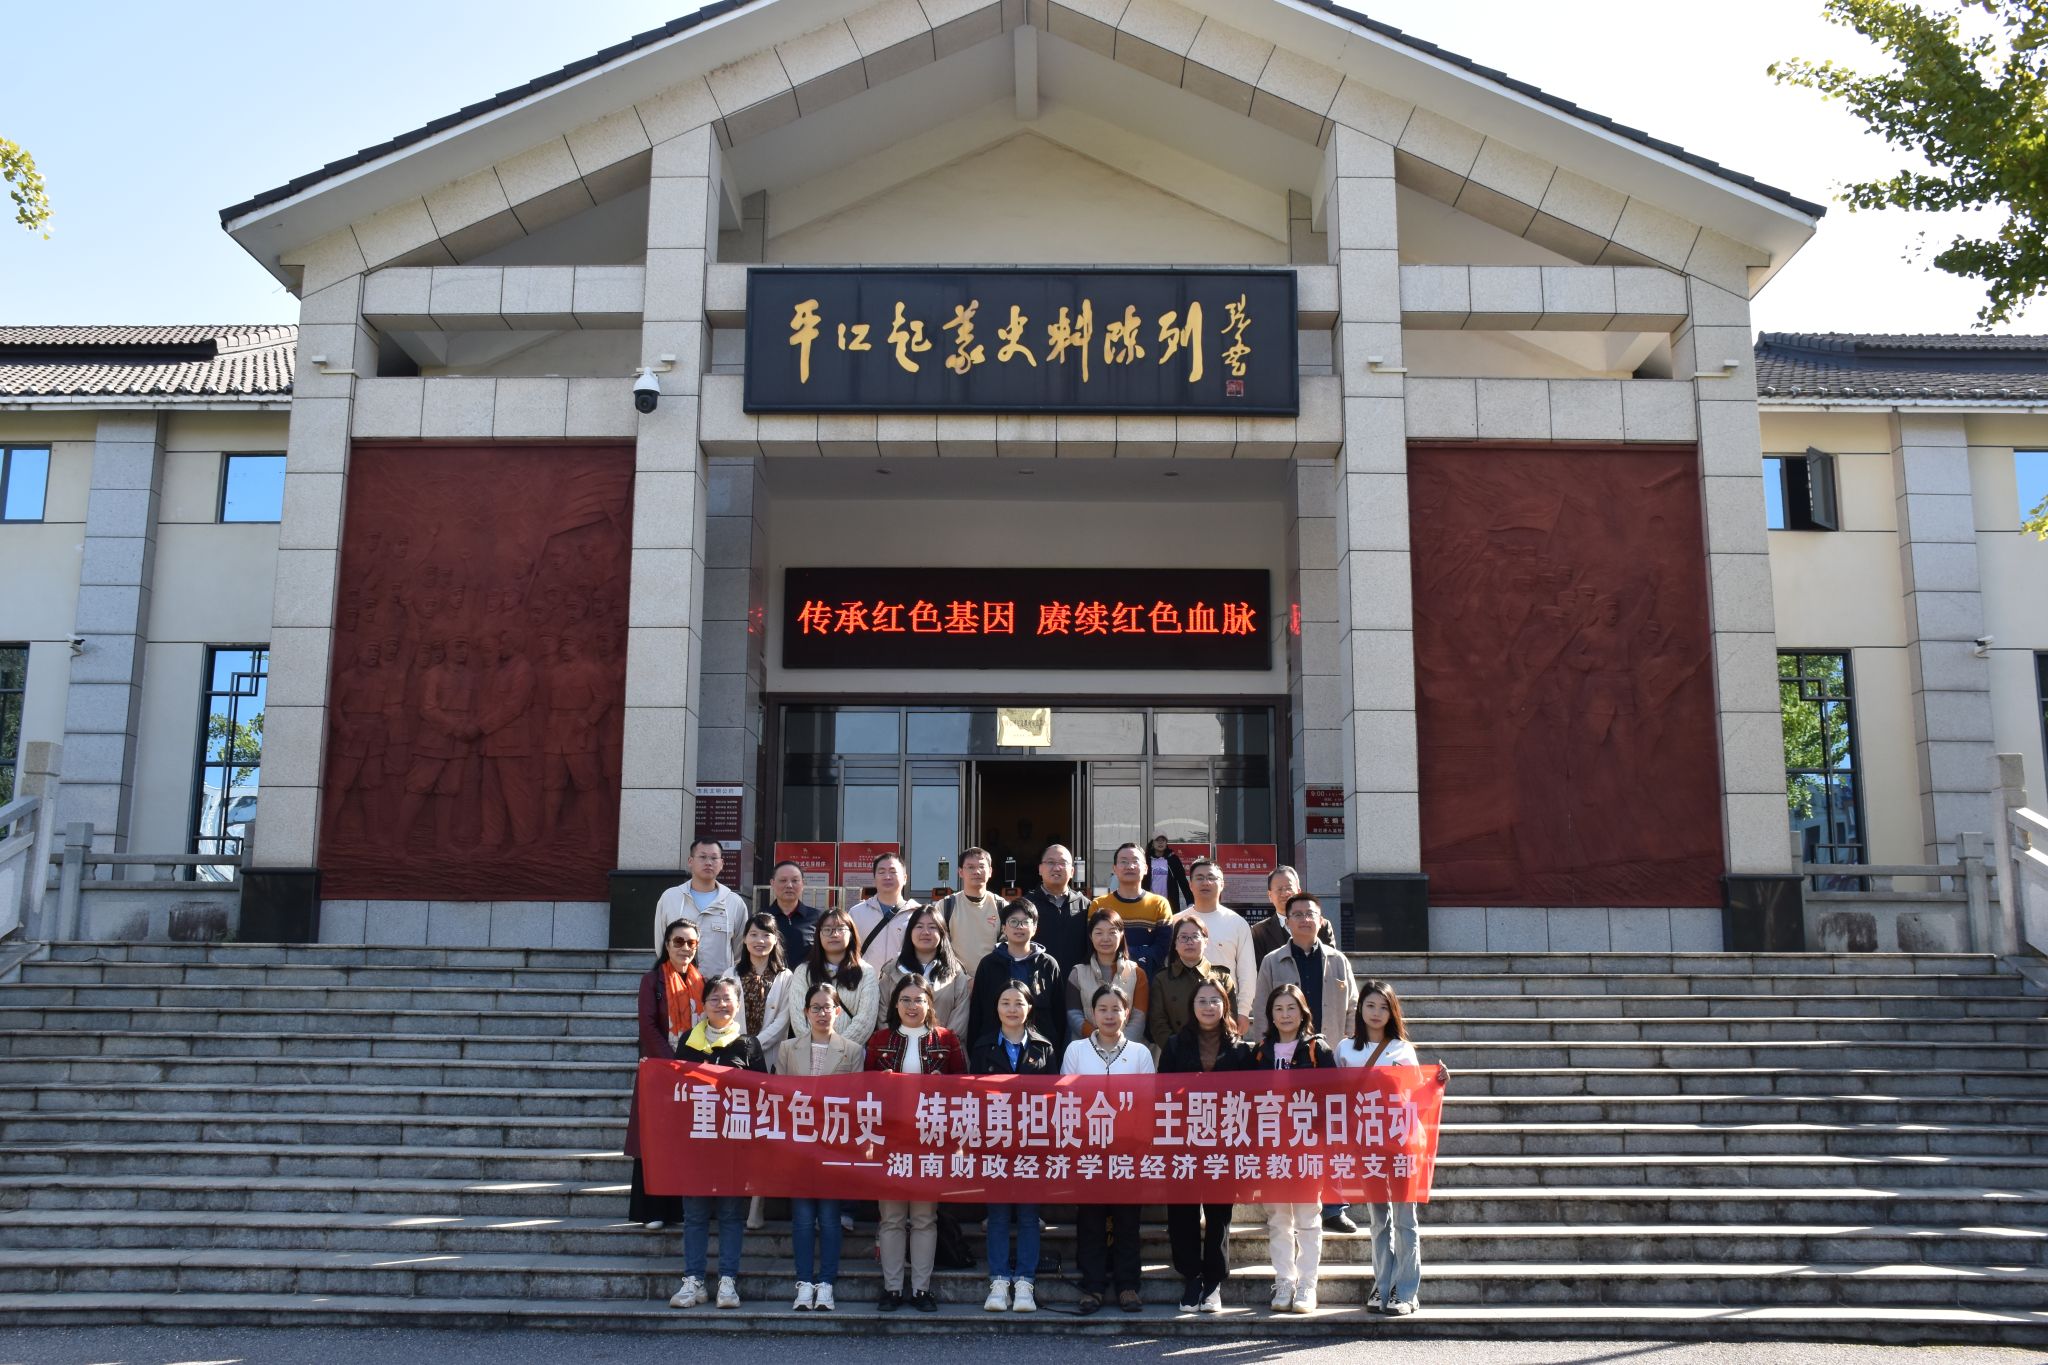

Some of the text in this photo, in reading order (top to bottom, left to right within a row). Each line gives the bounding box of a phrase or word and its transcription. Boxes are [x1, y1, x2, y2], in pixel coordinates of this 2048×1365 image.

[798, 600, 1257, 635] 传承红色基因 赓续红色血脉
[674, 1082, 1420, 1149] “重温红色历史 铸魂勇担使命” 主题教育党日活动
